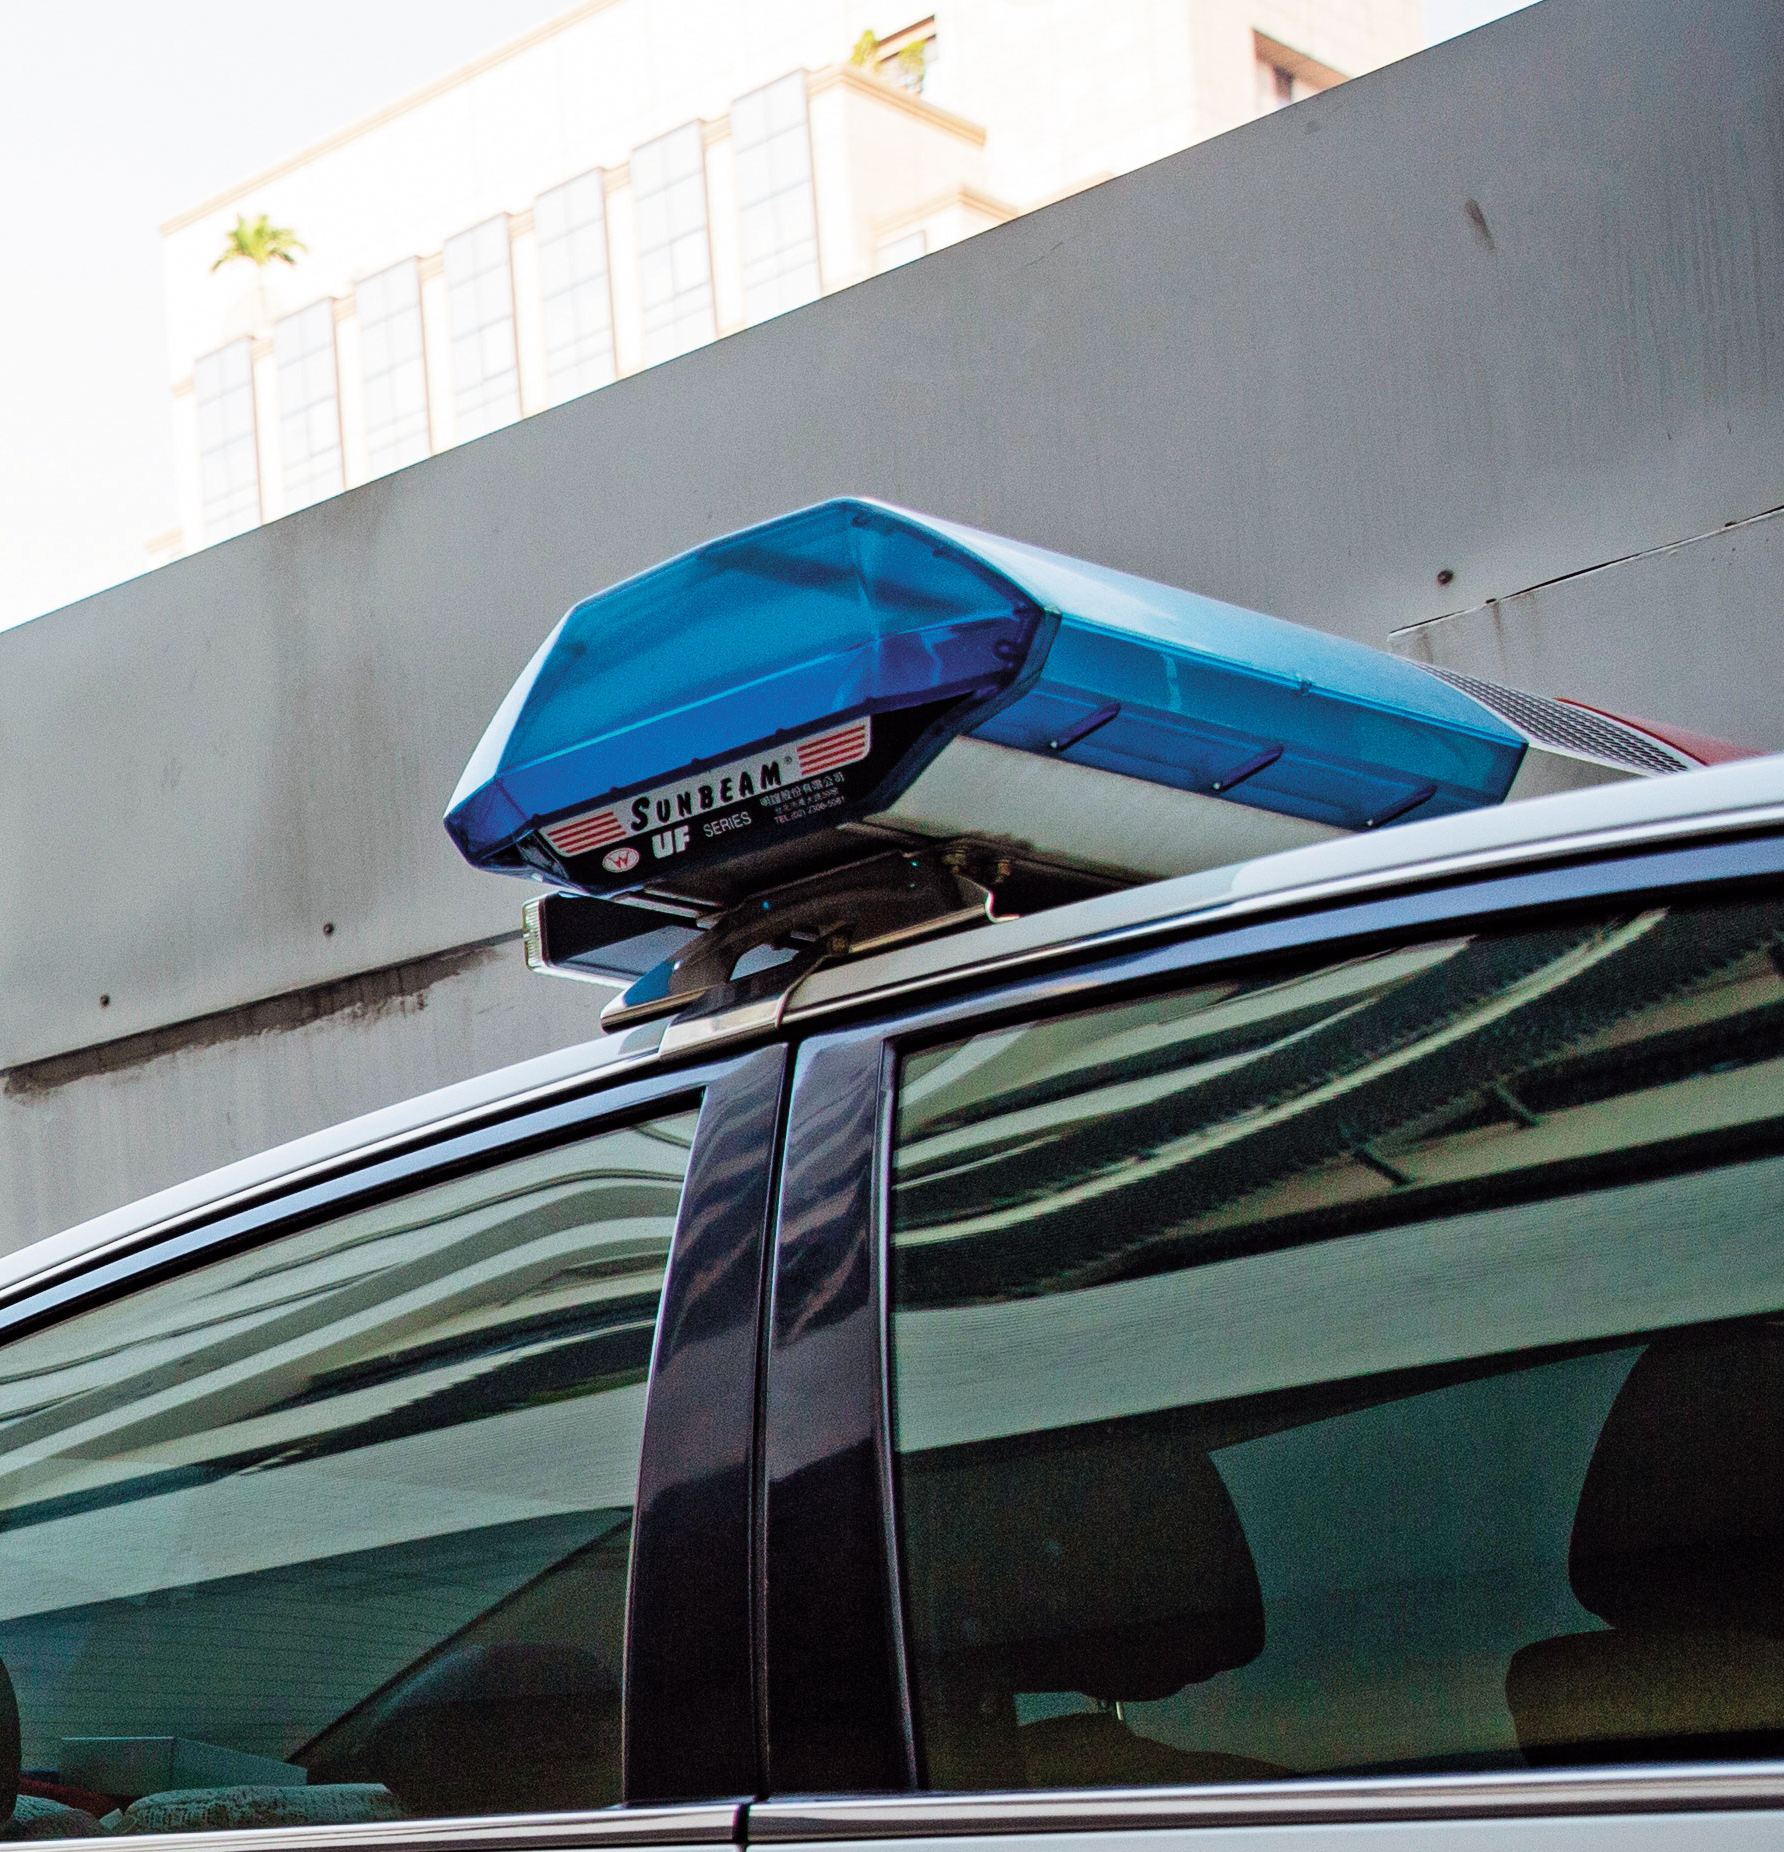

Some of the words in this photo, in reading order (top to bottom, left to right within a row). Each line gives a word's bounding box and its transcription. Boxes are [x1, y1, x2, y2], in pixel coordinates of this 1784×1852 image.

[631, 761, 781, 831] SUNBEAM
[651, 825, 691, 859] UF
[703, 811, 752, 838] SERIES
